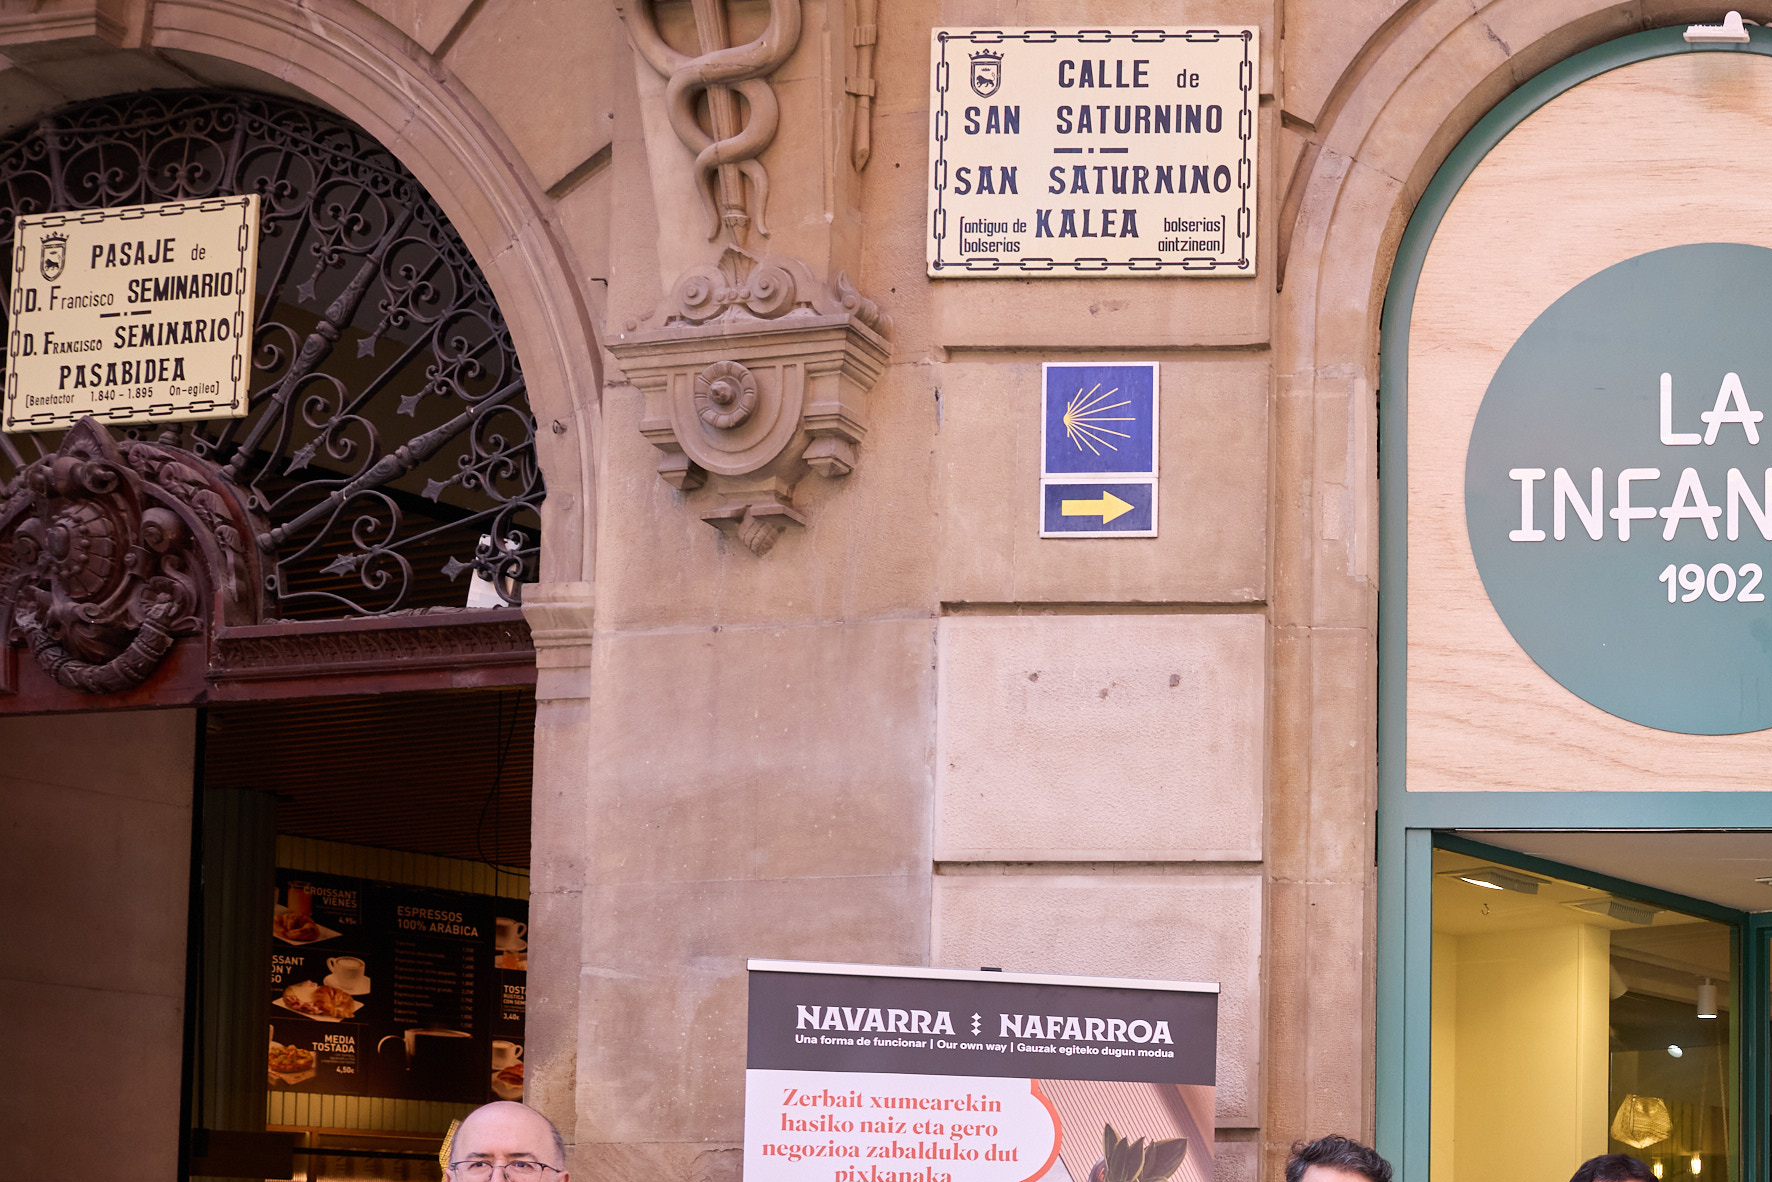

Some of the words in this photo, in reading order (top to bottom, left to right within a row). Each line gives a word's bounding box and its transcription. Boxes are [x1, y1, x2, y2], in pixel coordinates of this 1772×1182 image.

[1058, 59, 1150, 88] CALLE
[1177, 68, 1199, 88] de
[964, 105, 1021, 135] SAN
[1056, 104, 1223, 134] SATURNINO
[954, 165, 1018, 195] SAN
[1048, 164, 1232, 195] SATURNINO
[1013, 218, 1027, 234] de
[1035, 208, 1139, 239] KALEA
[91, 238, 175, 269] PASAJE
[191, 244, 206, 261] de
[25, 288, 41, 312] D.
[50, 286, 114, 310] Francisco
[128, 272, 233, 304] SEMINARIO
[23, 333, 38, 356] D.
[114, 318, 230, 349] SEMINARIO
[58, 357, 186, 390] PASABIDEA
[90, 390, 116, 402] 1.840
[127, 387, 153, 400] 1.895
[1660, 372, 1764, 446] LA
[1659, 562, 1765, 603] 1902
[304, 884, 358, 900] CROISSANT
[397, 906, 463, 923] ESPRESSOS
[397, 918, 427, 932] 100%
[429, 920, 479, 938] ARÁBICA
[271, 954, 305, 967] SSANT
[503, 984, 526, 997] TOST
[796, 1004, 956, 1035] NAVARRA
[999, 1013, 1174, 1045] NAFARROA
[312, 1041, 355, 1053] TOSTADA
[324, 1034, 355, 1045] MEDIA
[795, 1034, 818, 1044] Una
[820, 1035, 854, 1046] forma
[856, 1036, 871, 1046] de
[873, 1037, 927, 1048] funcionar
[937, 1039, 958, 1049] Our
[960, 1041, 983, 1050] own
[985, 1042, 1007, 1053] way
[1017, 1042, 1056, 1054] Gauzak
[1058, 1045, 1099, 1056] egiteko
[1101, 1046, 1135, 1058] dugun
[1138, 1047, 1174, 1058] modua
[782, 1088, 863, 1108] Zerbait
[870, 1094, 1002, 1112] xumearekin
[781, 1113, 854, 1133] hasiko
[860, 1116, 907, 1134] naiz
[912, 1119, 944, 1135] eta
[950, 1122, 998, 1141] gero
[762, 1140, 860, 1162] negozioa
[866, 1141, 979, 1161] zabalduko
[984, 1143, 1019, 1162] dut
